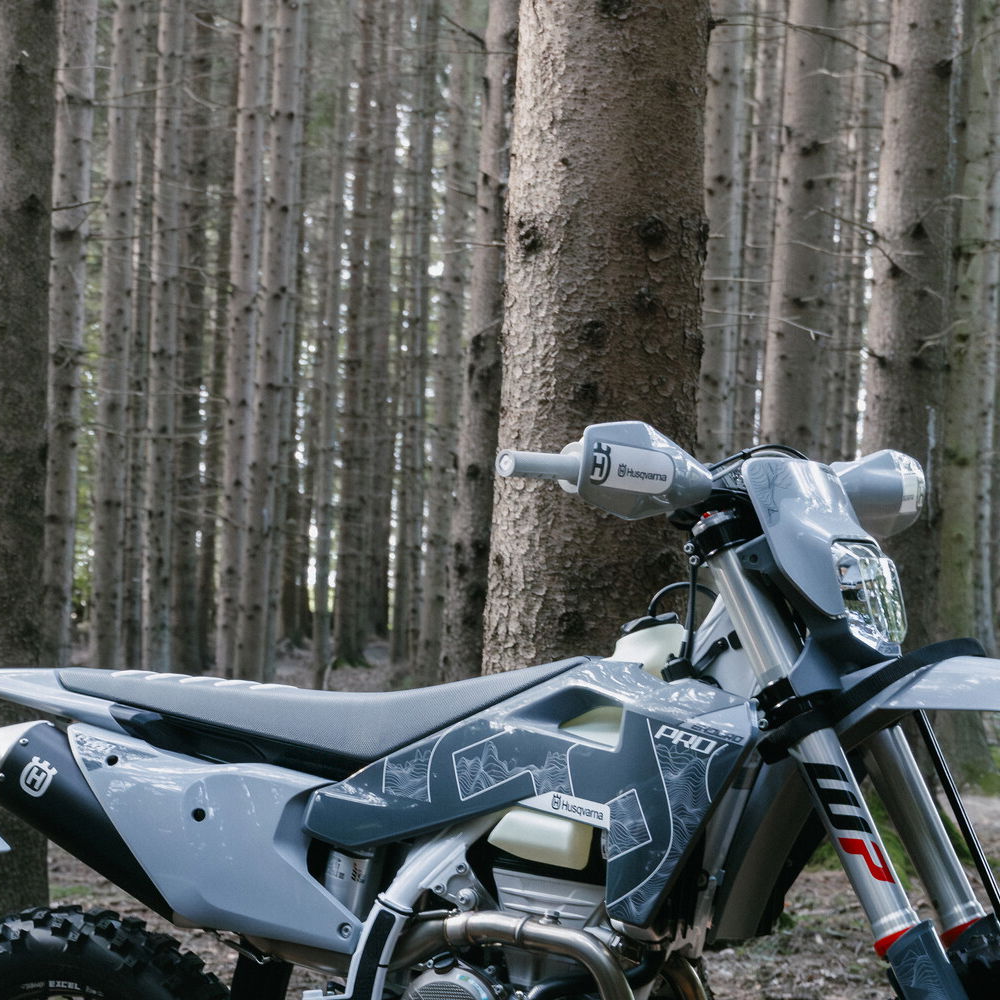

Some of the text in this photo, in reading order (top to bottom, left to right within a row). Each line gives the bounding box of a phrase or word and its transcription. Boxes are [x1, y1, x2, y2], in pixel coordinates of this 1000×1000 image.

[626, 467, 668, 482] Husqvarna
[653, 724, 718, 755] PRO
[561, 800, 604, 821] Husqvarna
